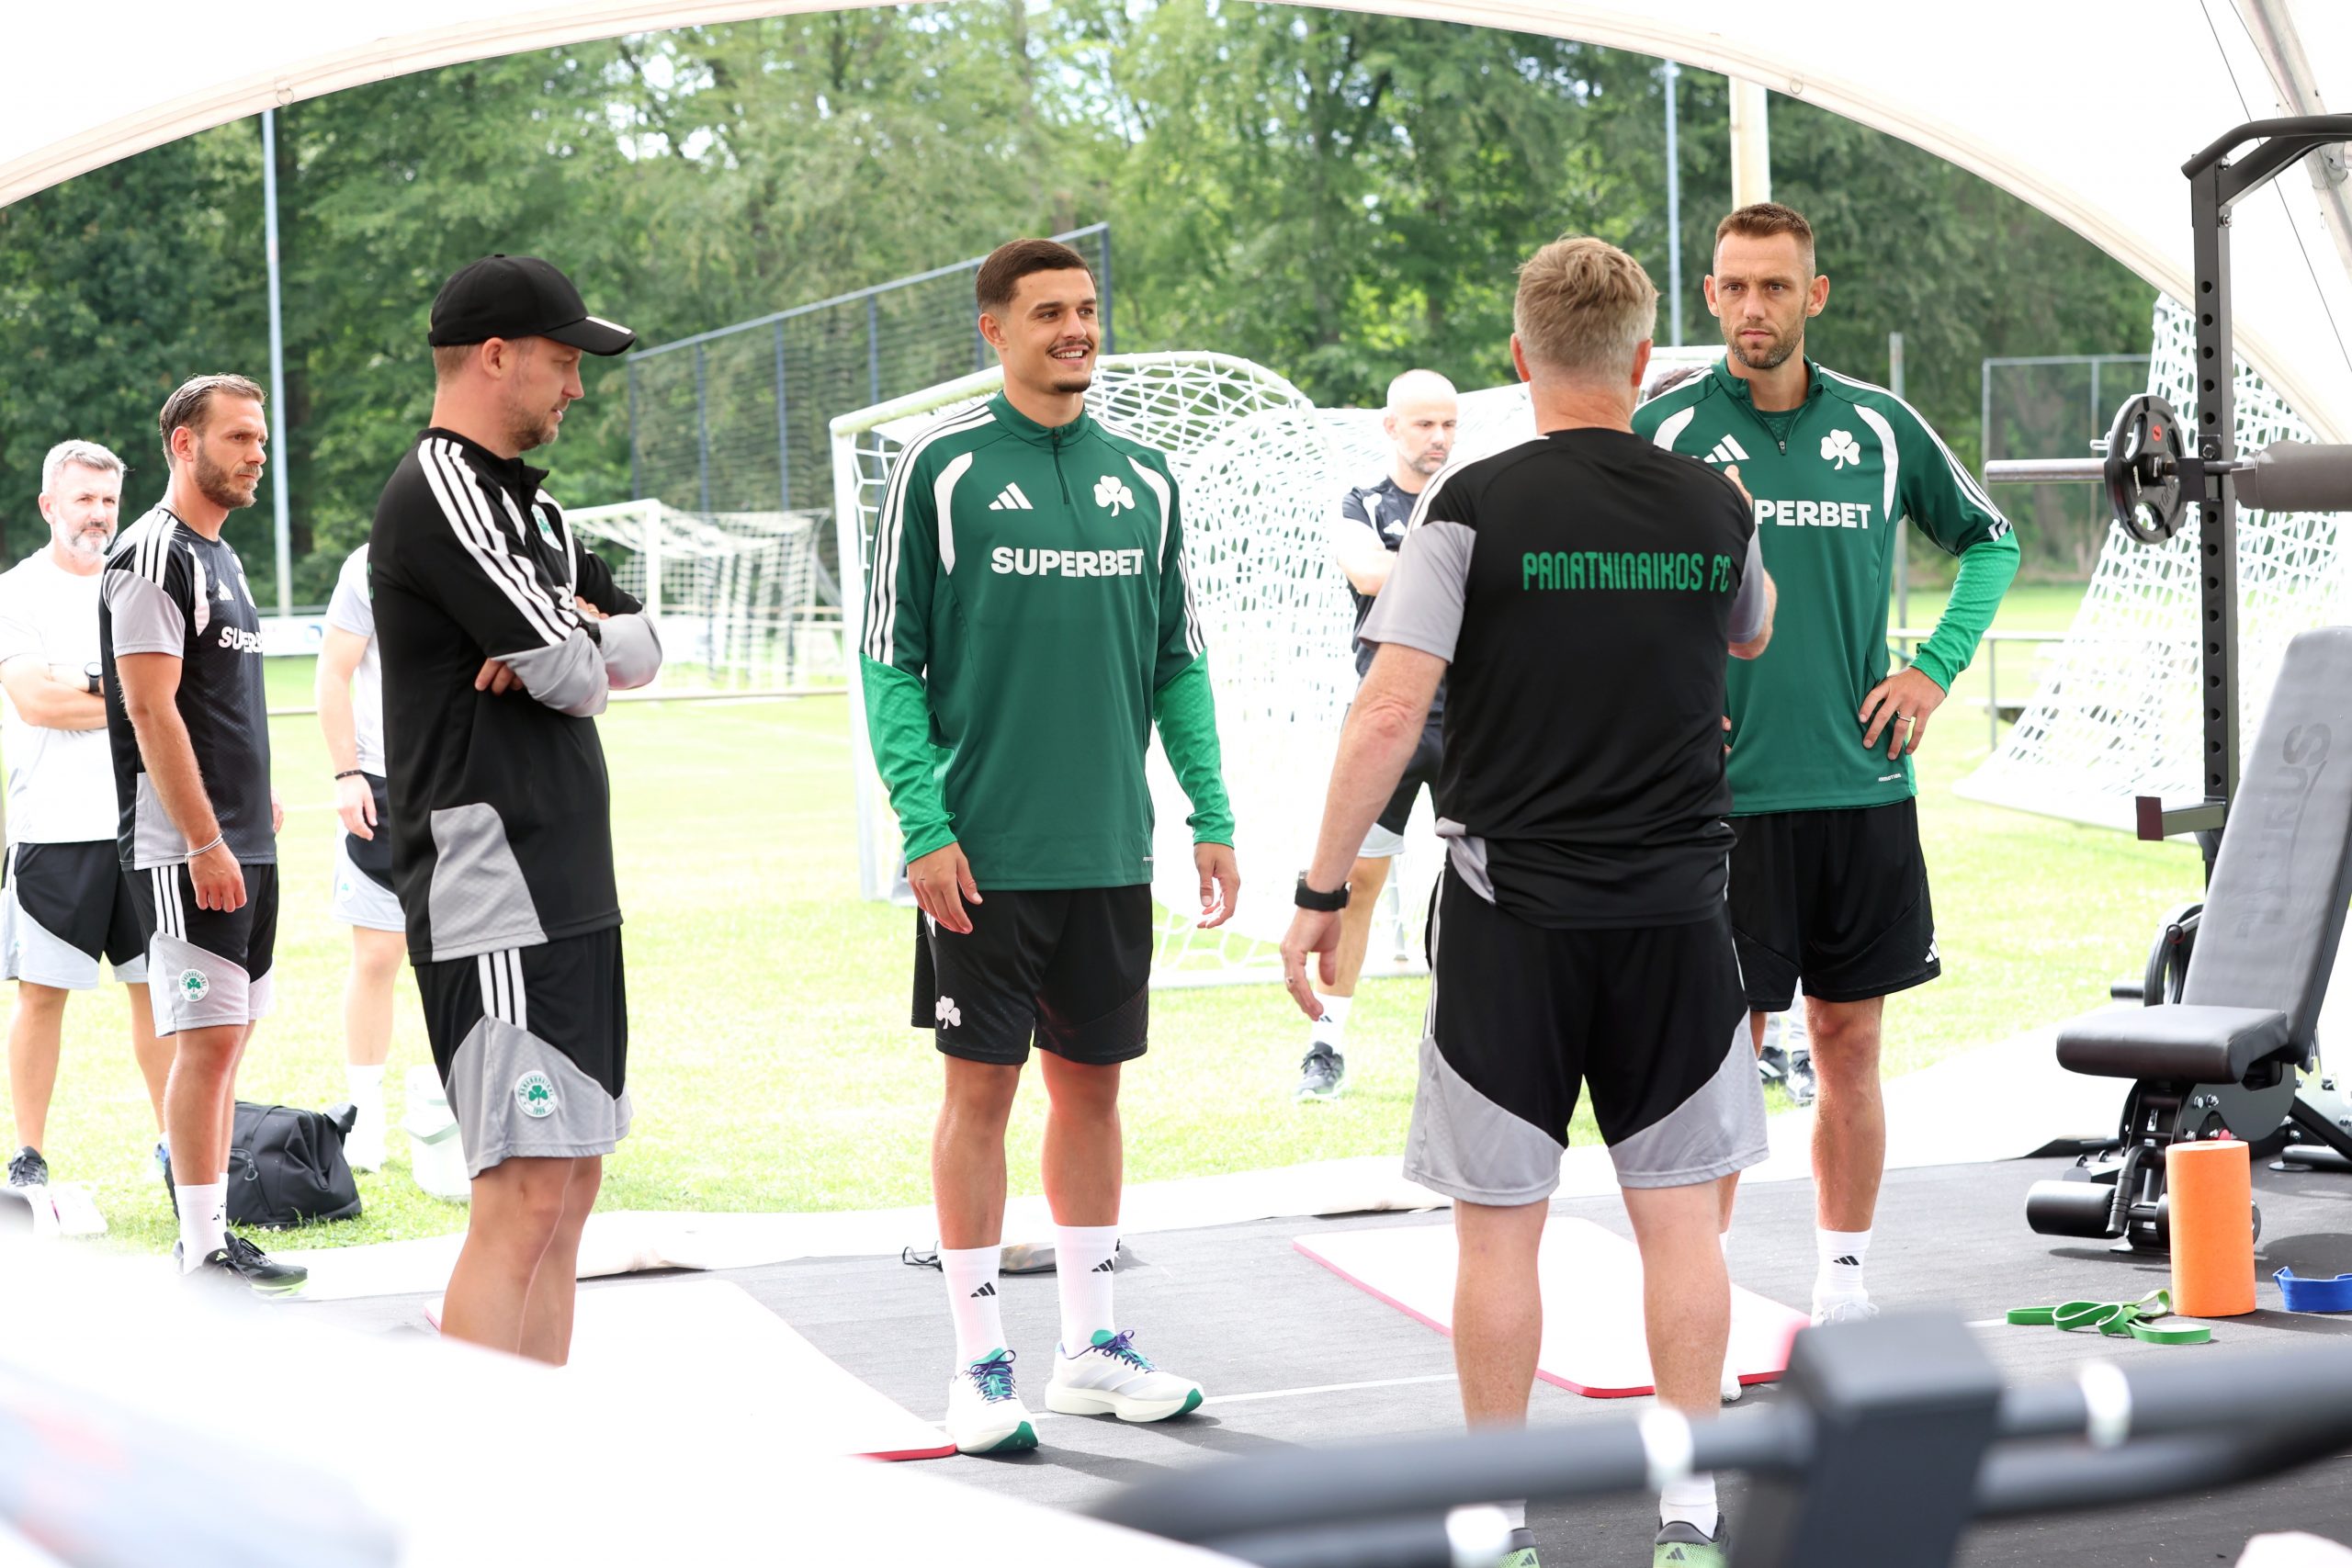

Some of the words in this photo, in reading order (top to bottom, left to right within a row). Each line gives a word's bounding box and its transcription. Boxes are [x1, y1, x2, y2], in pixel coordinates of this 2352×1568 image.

[1754, 499, 1871, 529] PERBET
[990, 547, 1145, 578] SUPERBET
[1522, 551, 1704, 591] PANATHINAIKOS
[1709, 555, 1731, 592] FC
